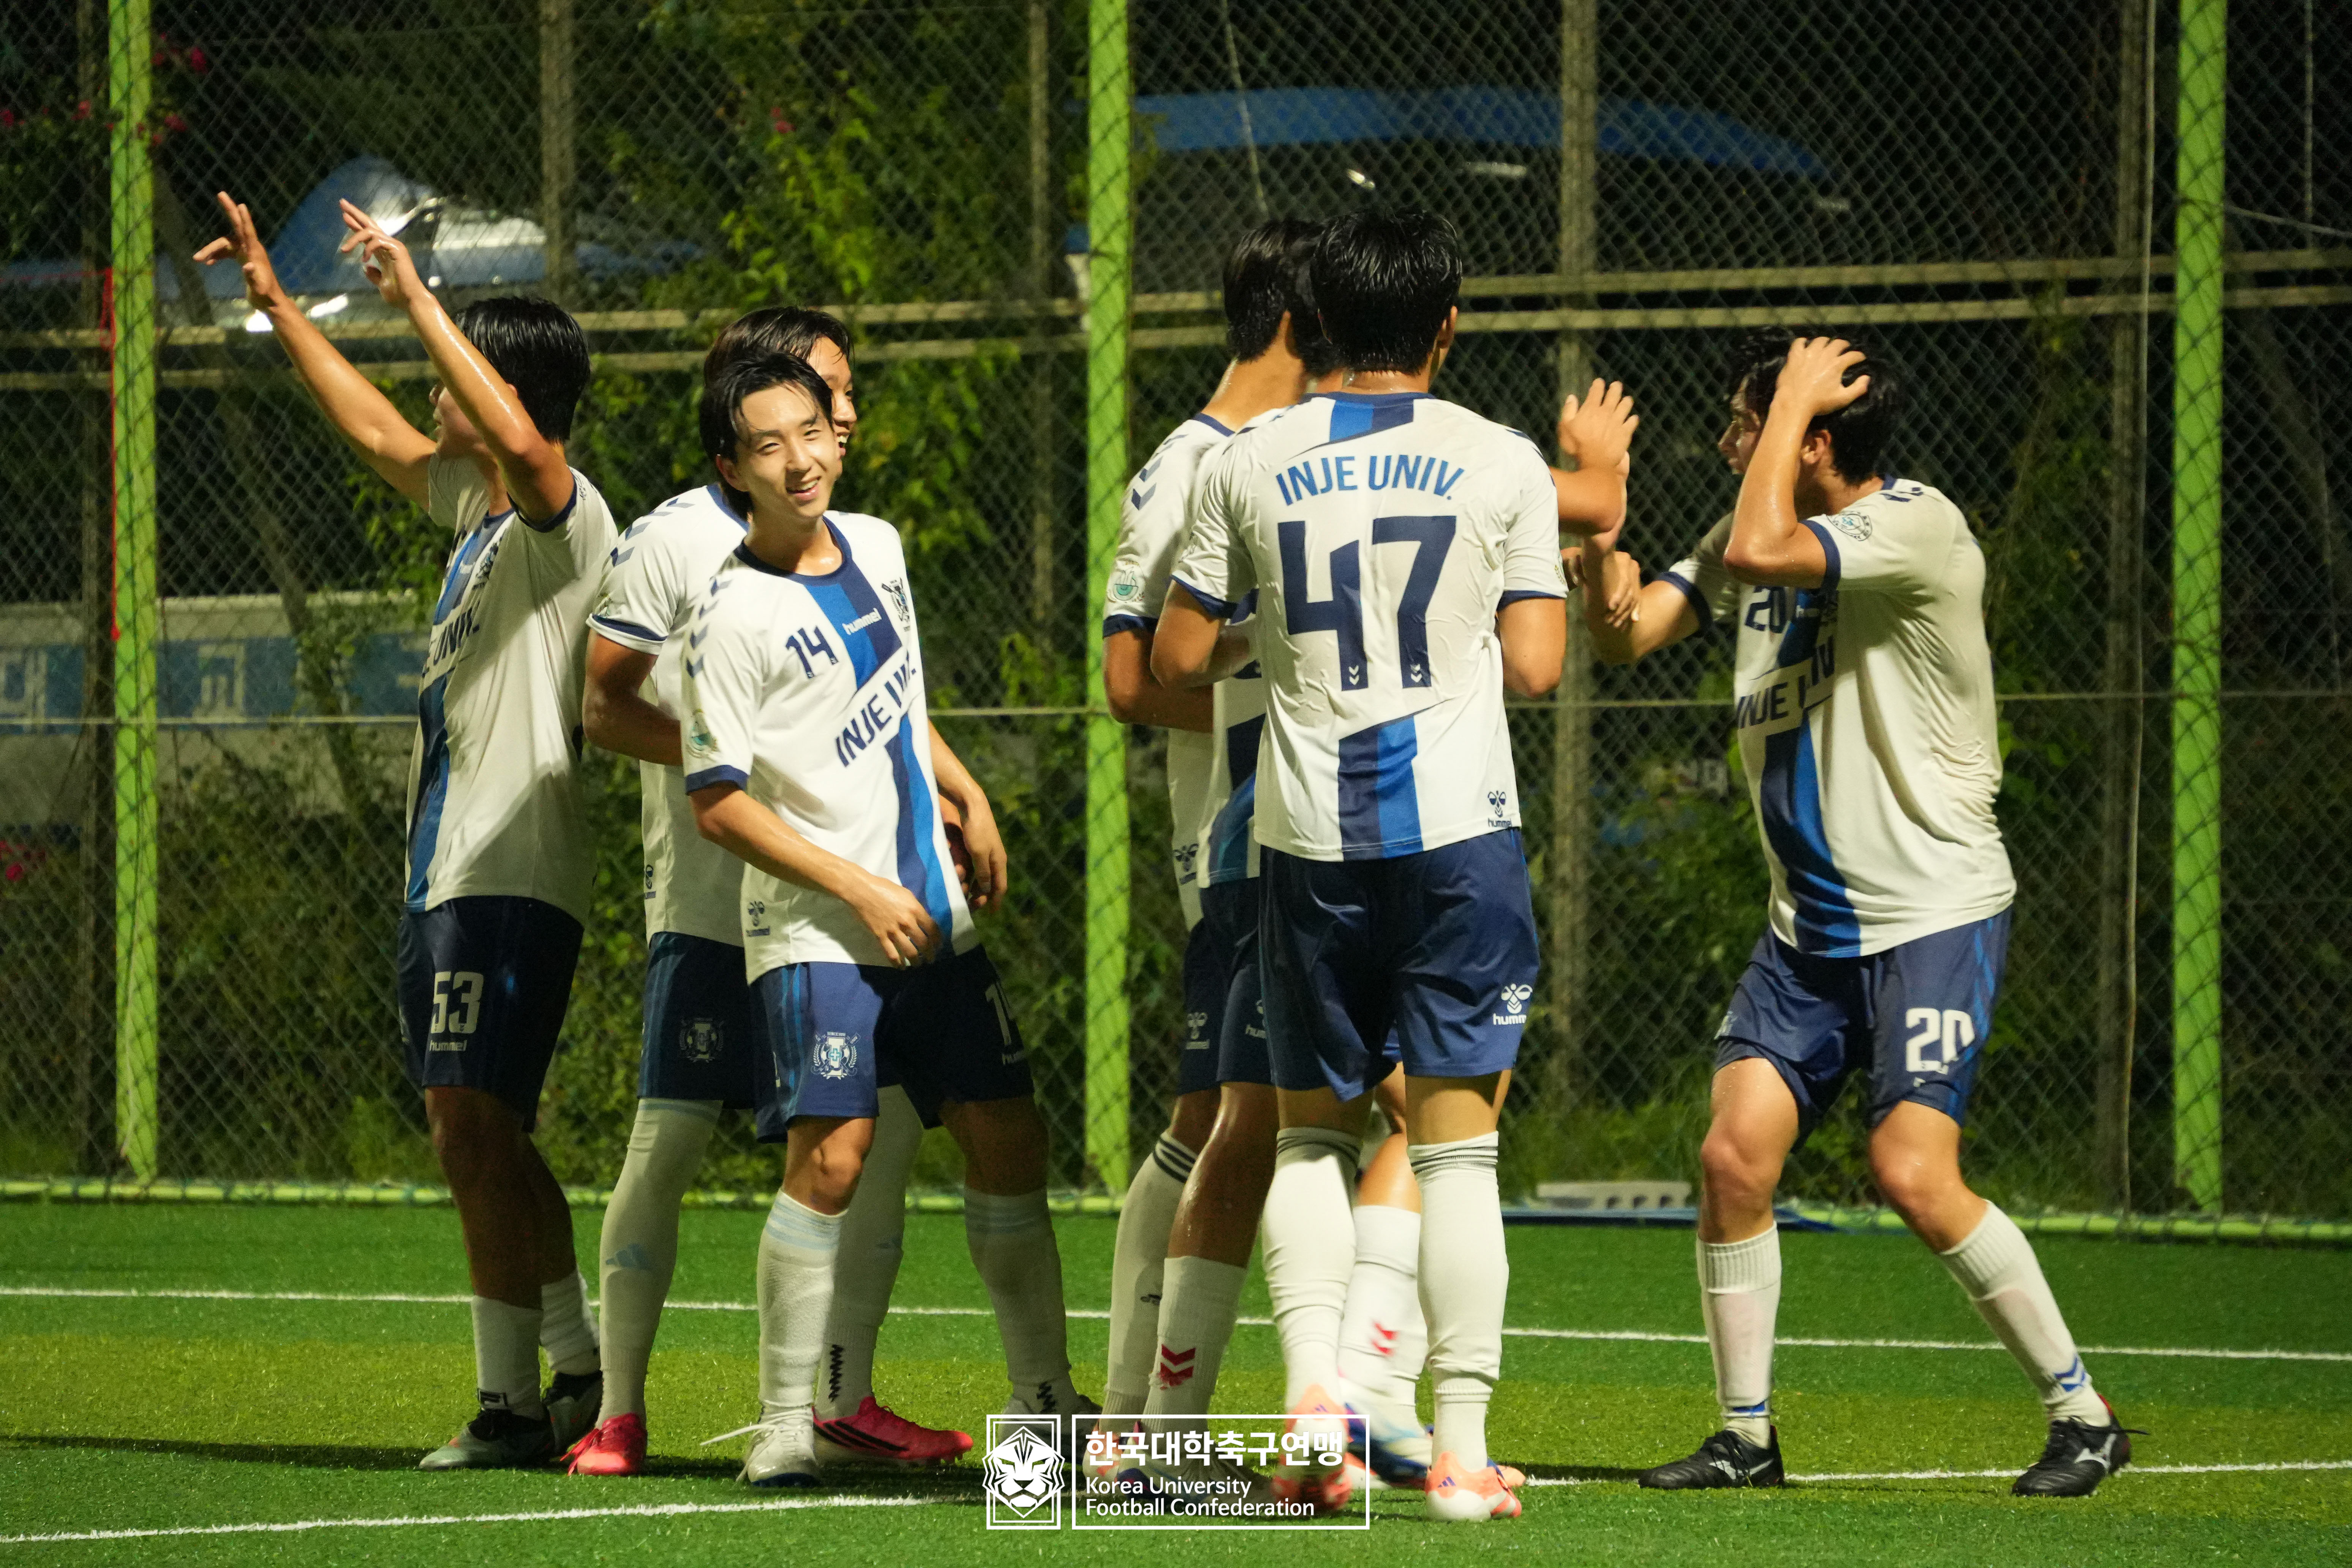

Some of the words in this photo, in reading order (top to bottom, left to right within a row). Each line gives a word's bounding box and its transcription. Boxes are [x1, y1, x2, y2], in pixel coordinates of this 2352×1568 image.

[1276, 456, 1358, 506] INJE
[1368, 454, 1465, 501] UNIV.
[842, 607, 882, 635] hummel
[1277, 515, 1457, 692] 47
[786, 625, 838, 679] 14
[835, 693, 892, 768] INJE
[430, 971, 484, 1034] 53
[1493, 1013, 1527, 1025] humm
[429, 1039, 468, 1052] hummel
[1905, 1007, 1975, 1075] 20
